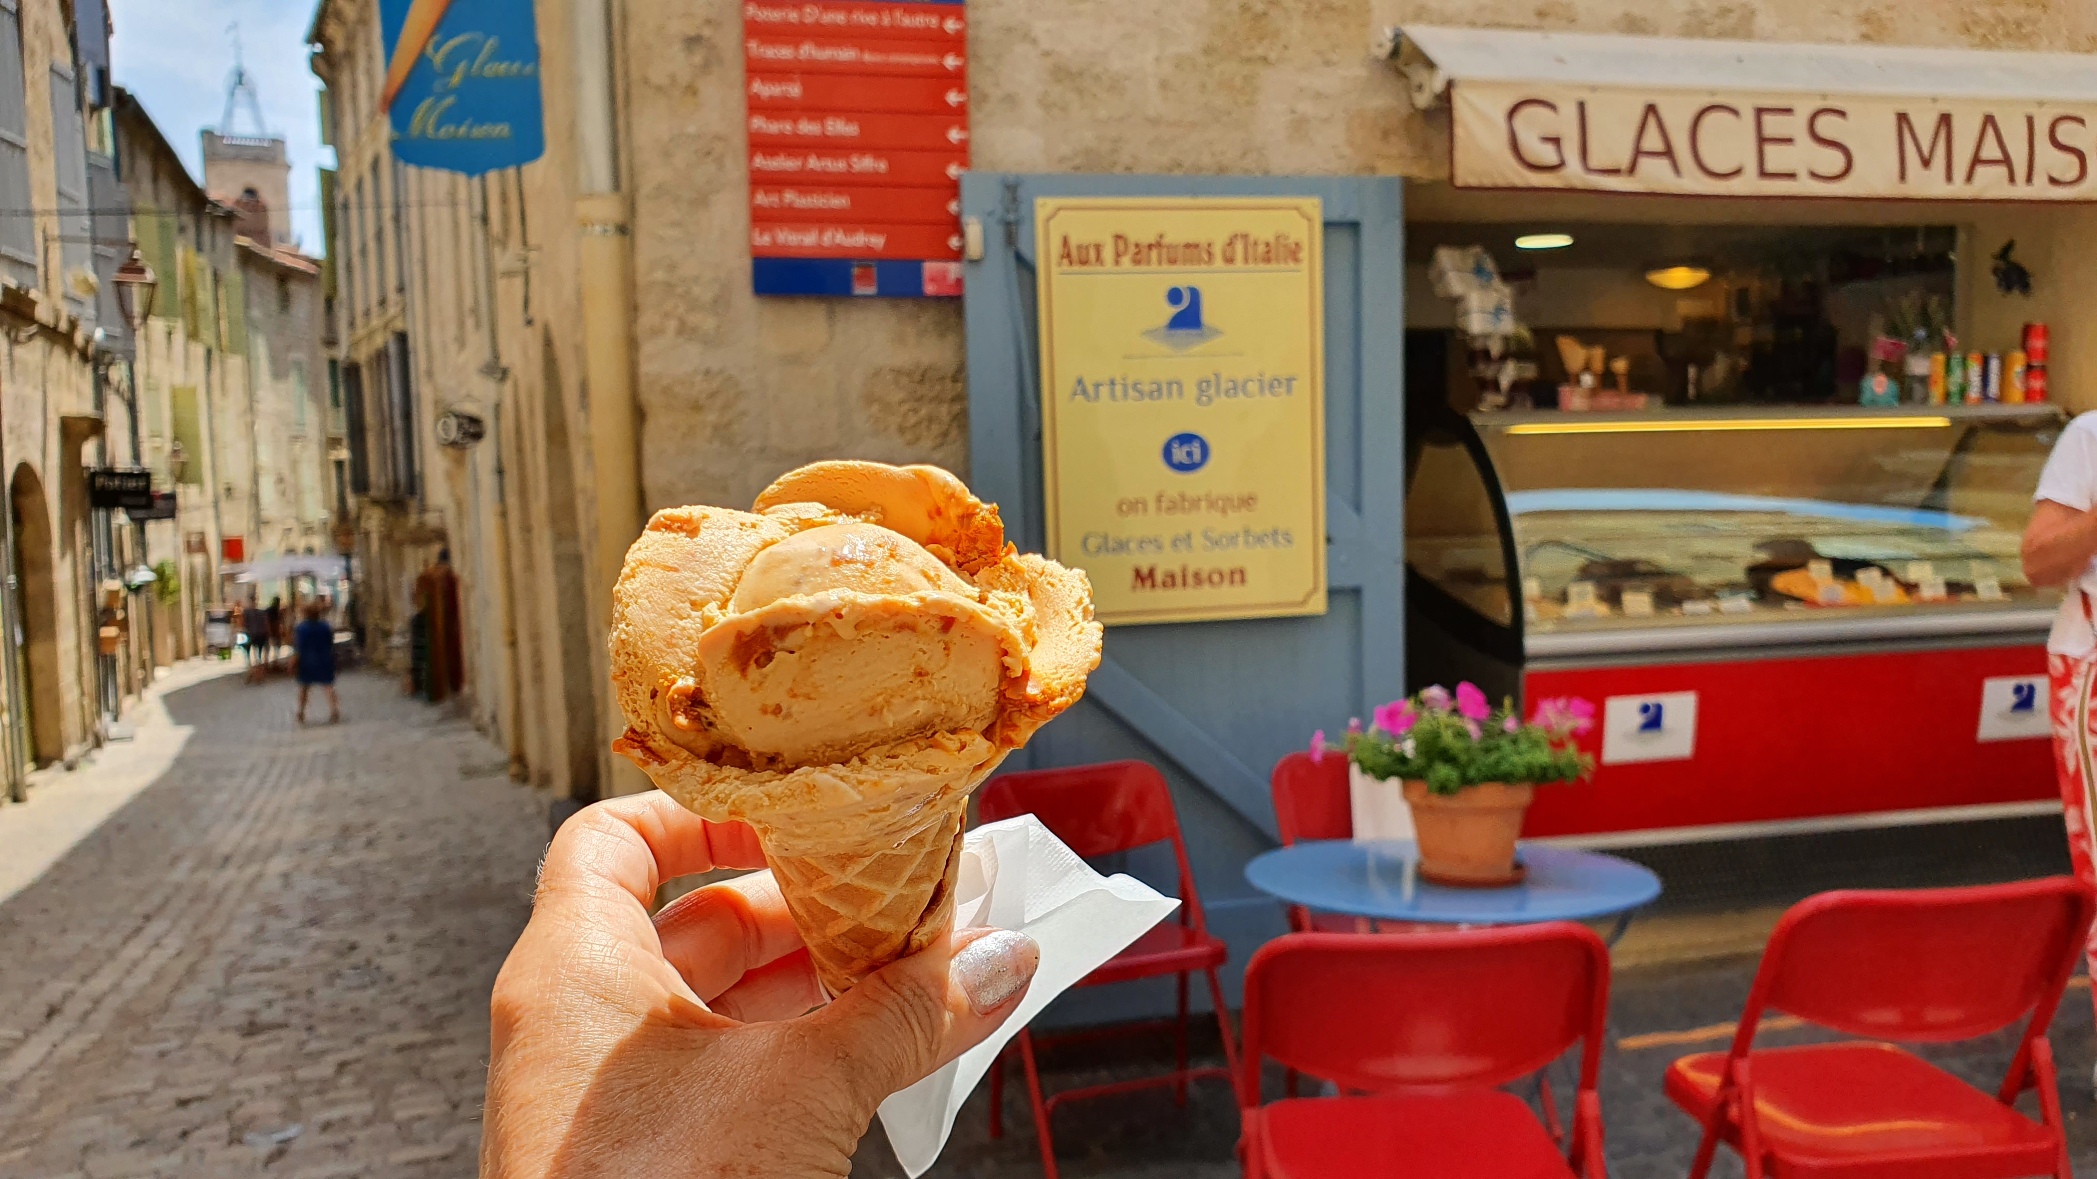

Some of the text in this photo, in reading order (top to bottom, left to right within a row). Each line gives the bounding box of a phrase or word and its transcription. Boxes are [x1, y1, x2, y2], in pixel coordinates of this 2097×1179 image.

[747, 41, 795, 59] Traces
[1506, 98, 2097, 187] GLACES MAIS
[1058, 232, 1303, 267] Aux Parfums d'Italie
[1070, 371, 1299, 406] Artisan glacier
[1171, 440, 1202, 464] ici
[1117, 491, 1258, 518] on fabrique
[1081, 527, 1294, 557] Glaces et Sorbets
[1131, 565, 1247, 592] Maison
